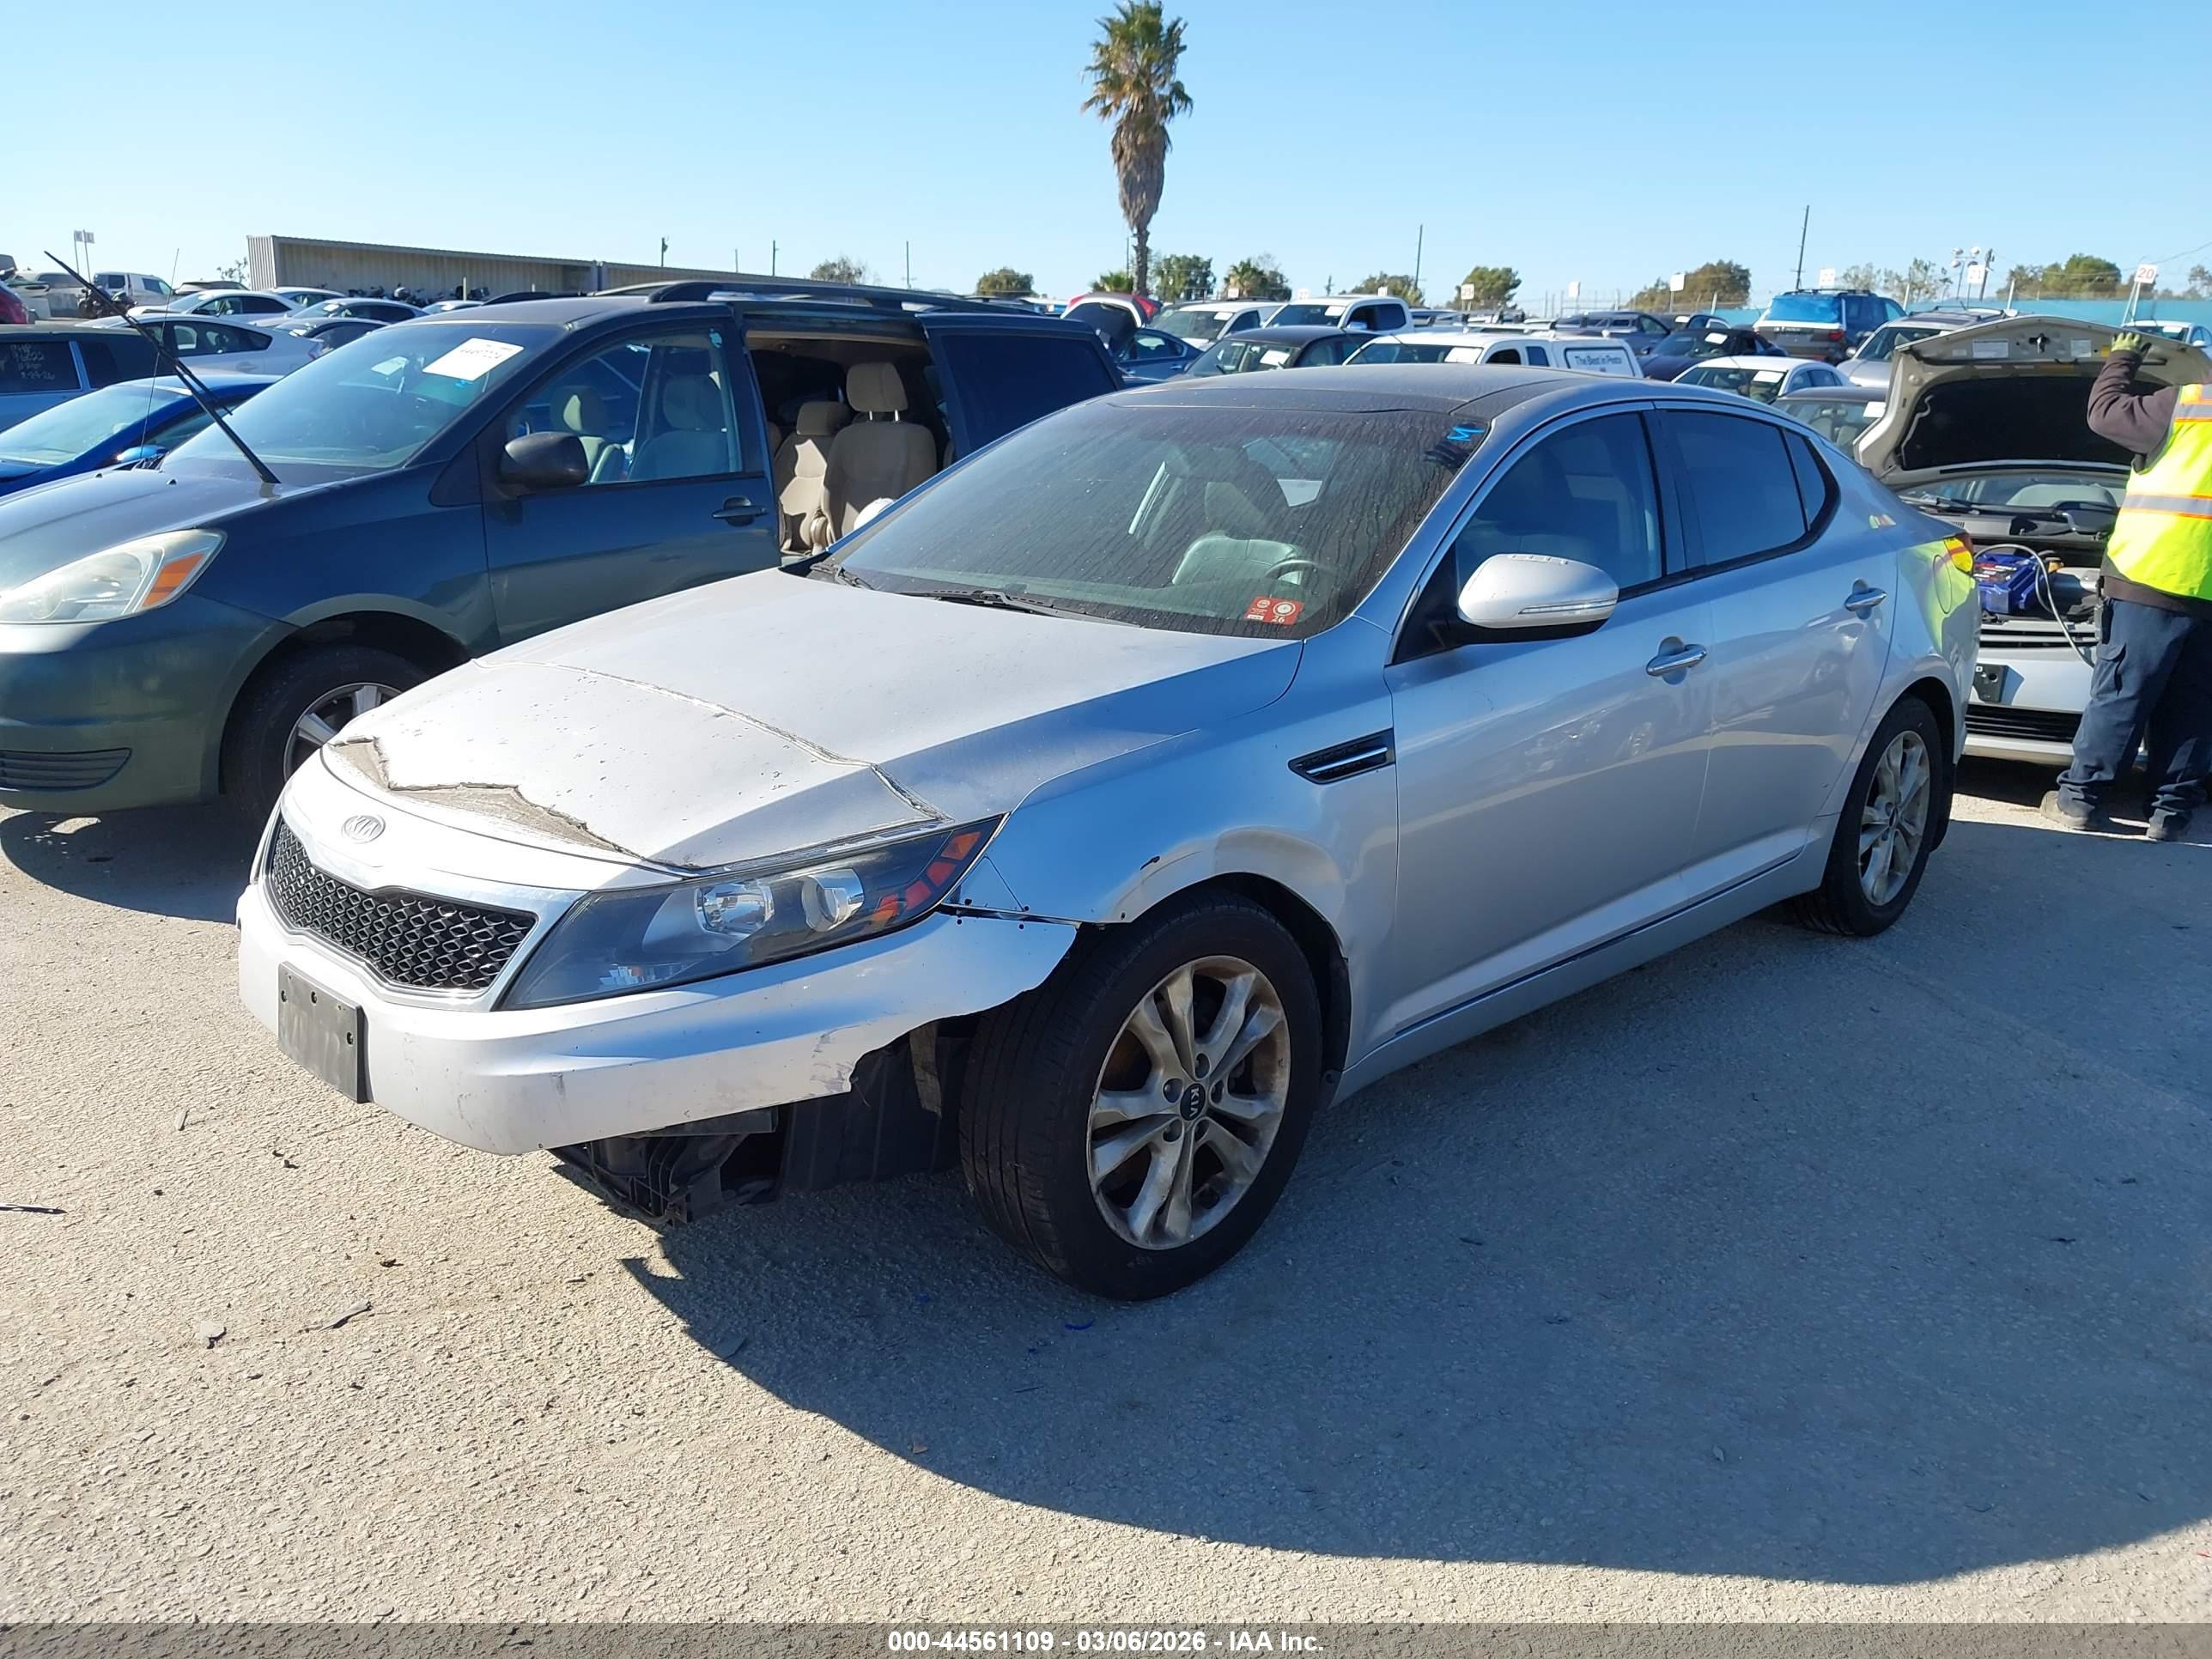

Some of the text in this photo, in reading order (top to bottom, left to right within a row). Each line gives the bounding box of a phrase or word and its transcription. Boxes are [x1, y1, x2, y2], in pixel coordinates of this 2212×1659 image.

[2137, 267, 2154, 279] 20
[1271, 615, 1285, 623] 26
[1189, 1086, 1200, 1117] KIA
